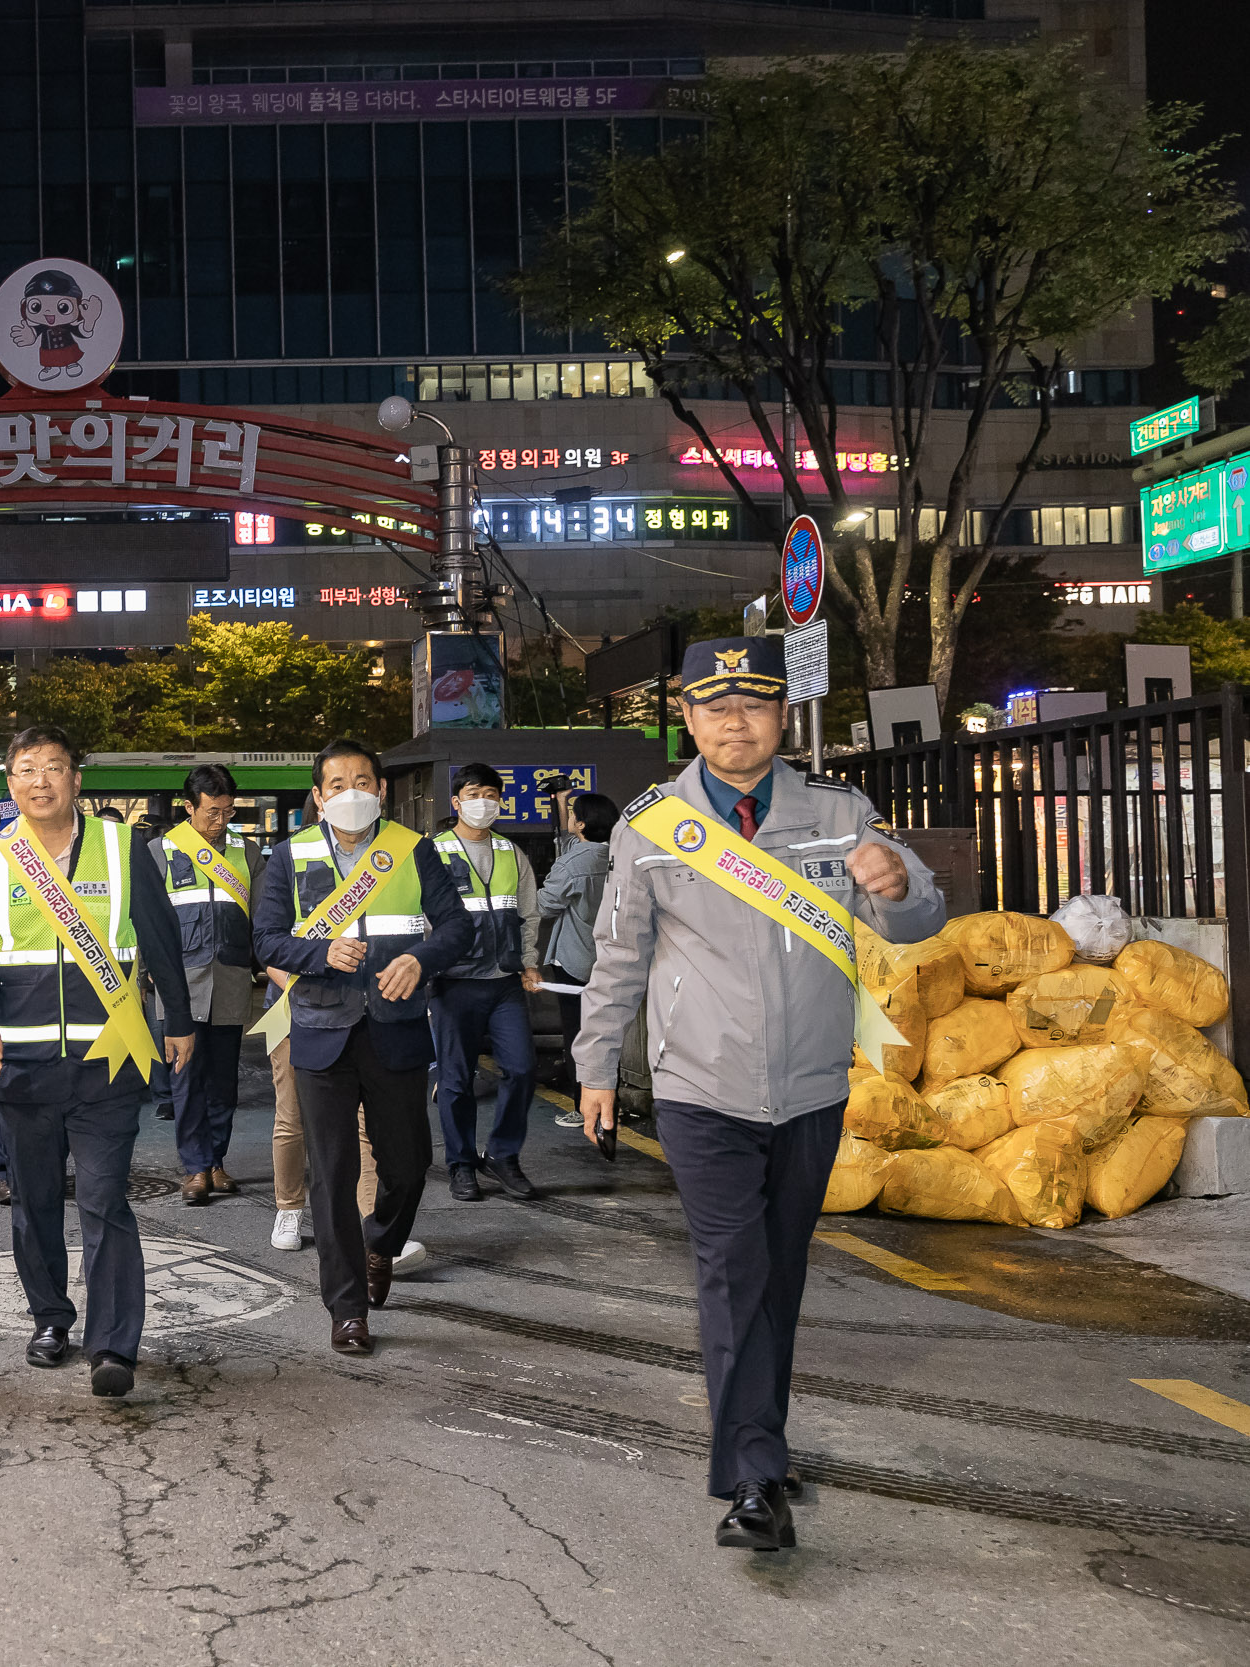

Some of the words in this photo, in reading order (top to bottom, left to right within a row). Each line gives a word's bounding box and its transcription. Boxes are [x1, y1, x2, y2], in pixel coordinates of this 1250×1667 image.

[436, 87, 591, 109] 스타시티아트웨딩홀
[596, 88, 617, 105] 5F
[1136, 405, 1193, 447] 건대입구역
[611, 451, 630, 465] 3F
[1042, 453, 1123, 465] STATION
[1151, 478, 1211, 517] 자양사거리
[645, 508, 729, 531] 정형외과
[193, 587, 295, 609] 로즈시티의원
[1100, 585, 1151, 604] HAIR
[717, 848, 786, 901] 범죄없는
[807, 861, 846, 877] 경찰
[327, 869, 379, 926] 범죄없는
[10, 837, 54, 889] 안전하고
[41, 879, 81, 927] 건전한
[68, 921, 106, 965] 청년의
[95, 955, 122, 994] 거리
